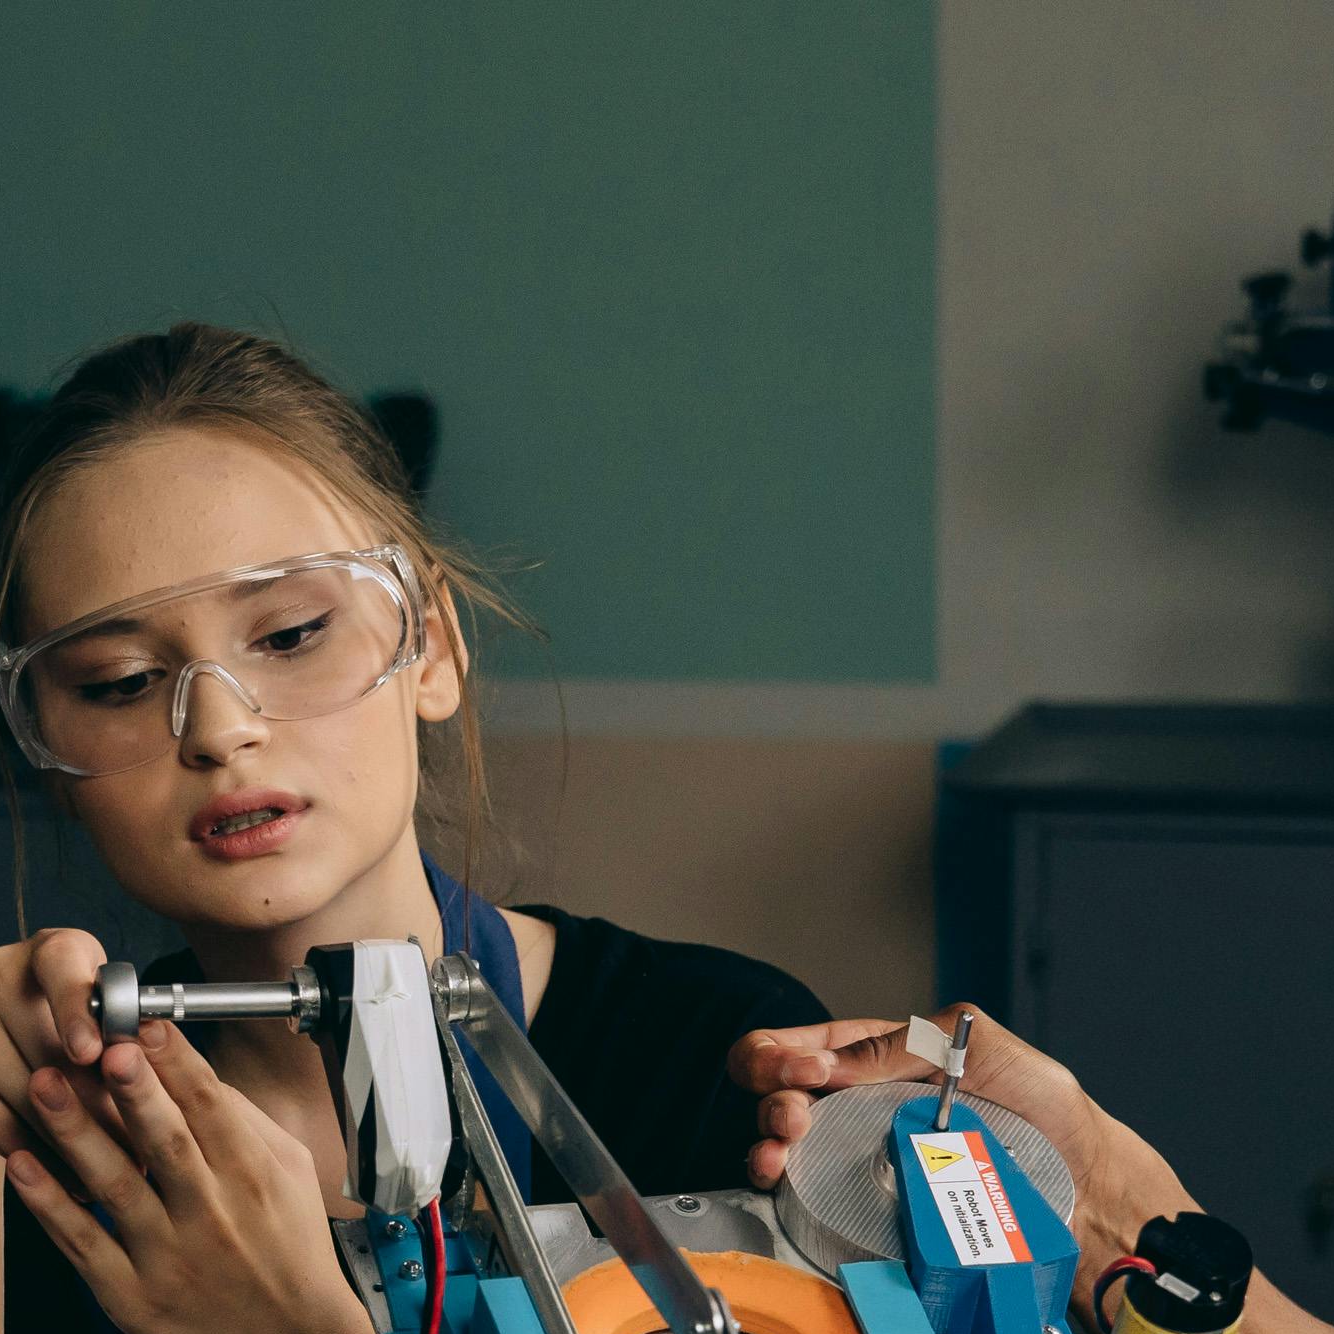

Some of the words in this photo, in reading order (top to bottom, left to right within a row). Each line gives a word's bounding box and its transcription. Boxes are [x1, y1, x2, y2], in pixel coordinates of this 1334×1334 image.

[947, 1190, 959, 1202] on
[963, 1189, 981, 1217] Robot
[976, 1219, 994, 1248] Moves
[982, 1171, 1017, 1232] WARNING
